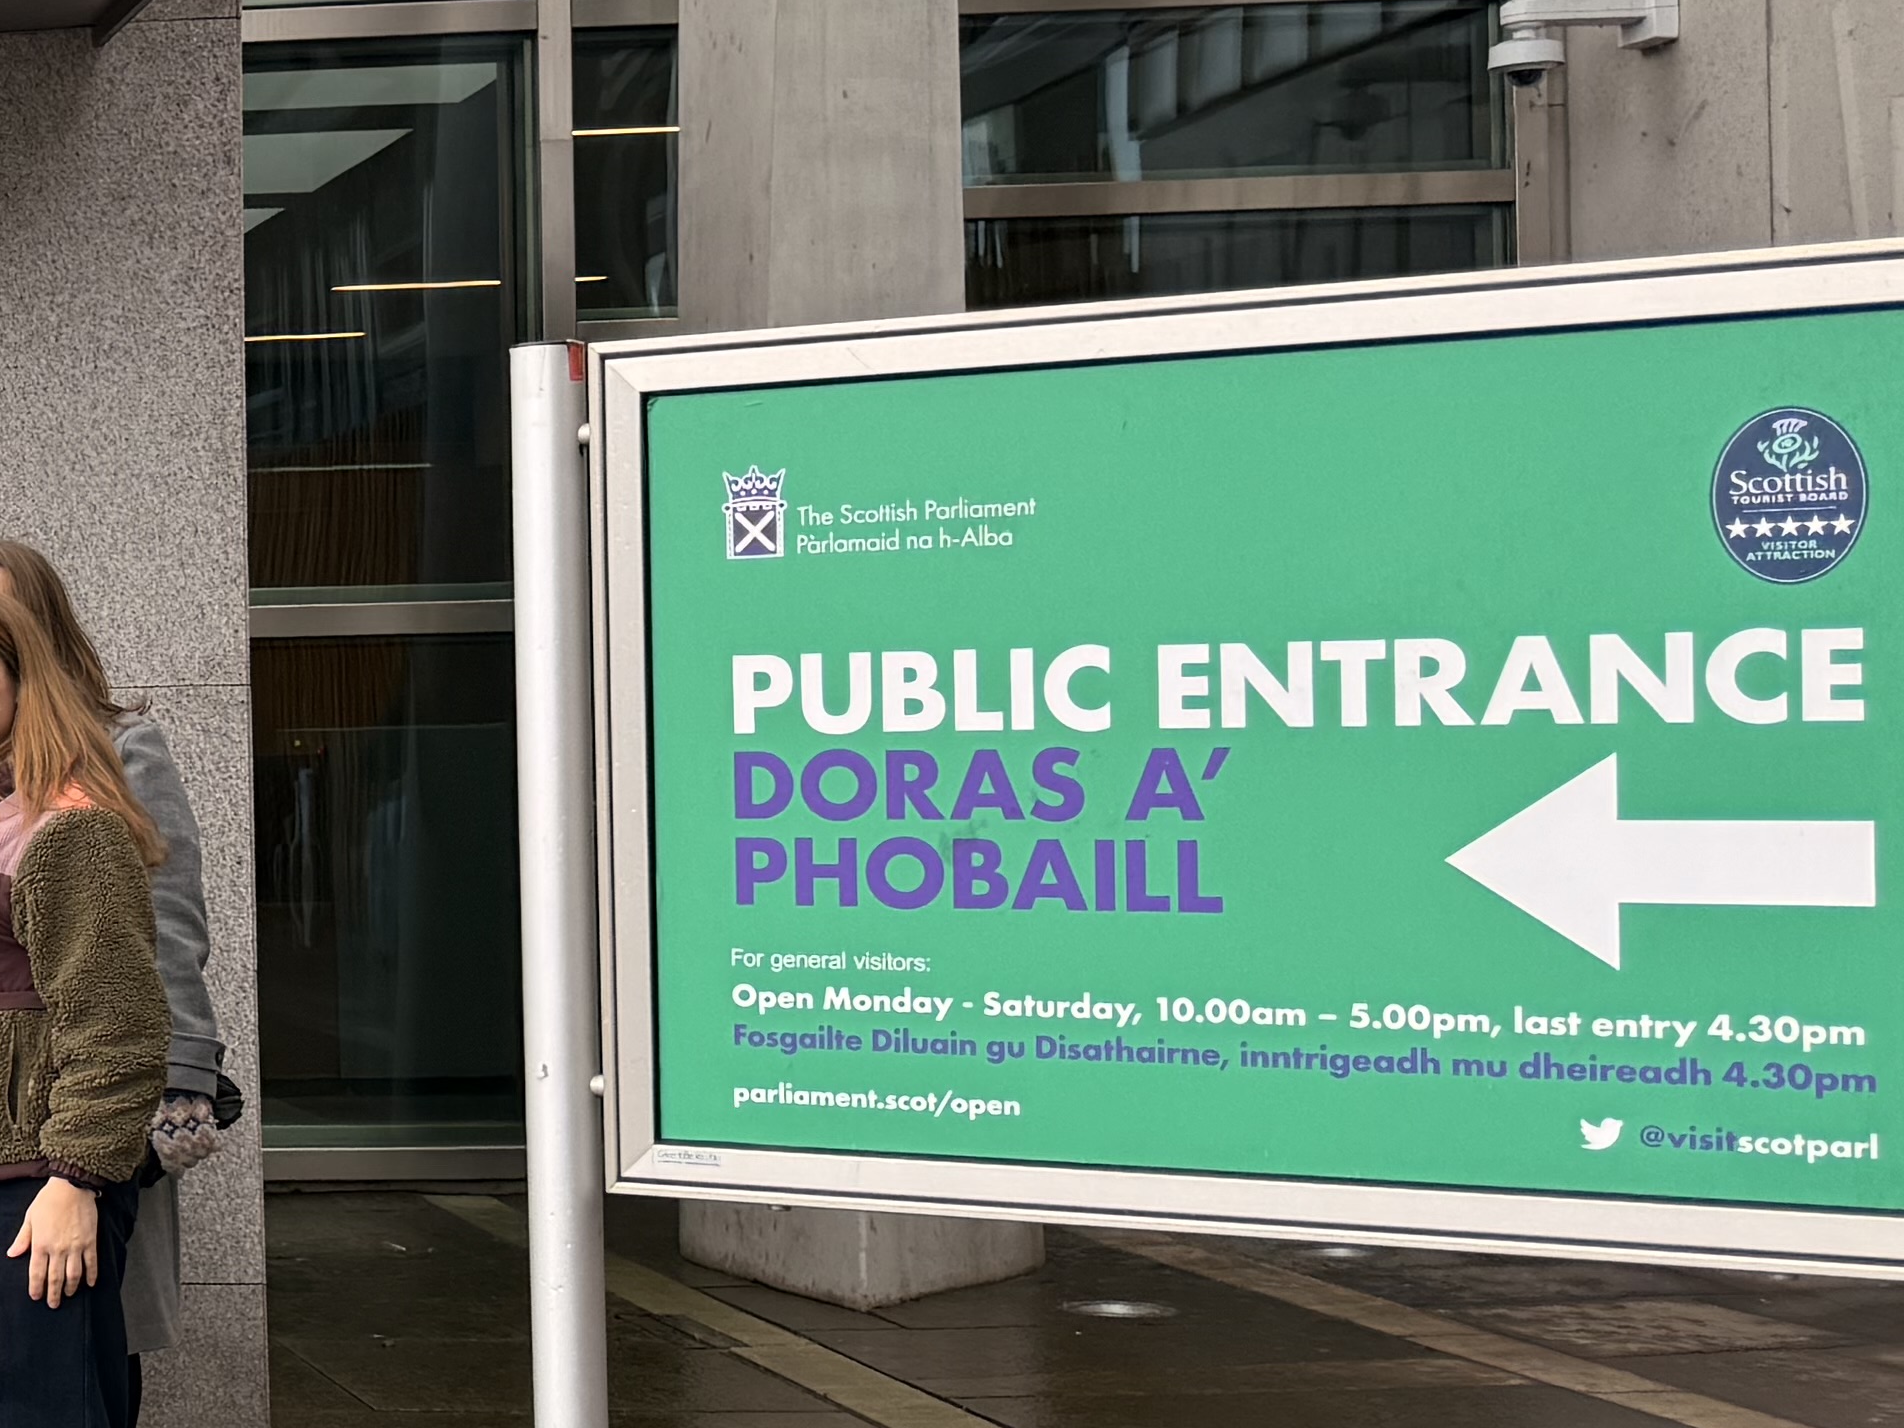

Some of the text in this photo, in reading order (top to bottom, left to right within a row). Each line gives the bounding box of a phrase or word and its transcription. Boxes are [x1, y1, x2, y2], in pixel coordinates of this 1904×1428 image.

[1729, 467, 1848, 495] Scottish
[1732, 491, 1849, 504] TOURIST BOARD
[797, 497, 1036, 526] The Scottish Parliament
[797, 524, 1012, 554] Pàrlamaid na h-Alba
[1746, 550, 1835, 561] ATTRACTION
[1761, 540, 1817, 550] VISITOR
[733, 628, 1864, 734] PUBLIC ENTRANCE
[735, 748, 1084, 822] DORAS
[736, 838, 1223, 913] PHOBAILL
[732, 948, 930, 975] For general visitors:
[733, 984, 813, 1014] Open
[824, 987, 953, 1021] Monday
[984, 992, 1141, 1027] Saturday,
[1157, 997, 1306, 1026] 10.00am
[1350, 1003, 1501, 1038] 5.00pm,
[1515, 1006, 1581, 1035] last
[1592, 1015, 1697, 1047] entry
[1708, 1015, 1865, 1052] 4.30pm
[734, 1025, 1877, 1098] Fosgailte Diluain gu Disathairne, inntrigeadh mu dheireadh 4.30pm
[734, 1083, 1020, 1120] parliament.scot/open
[1639, 1126, 1878, 1163] @visitscotparl
